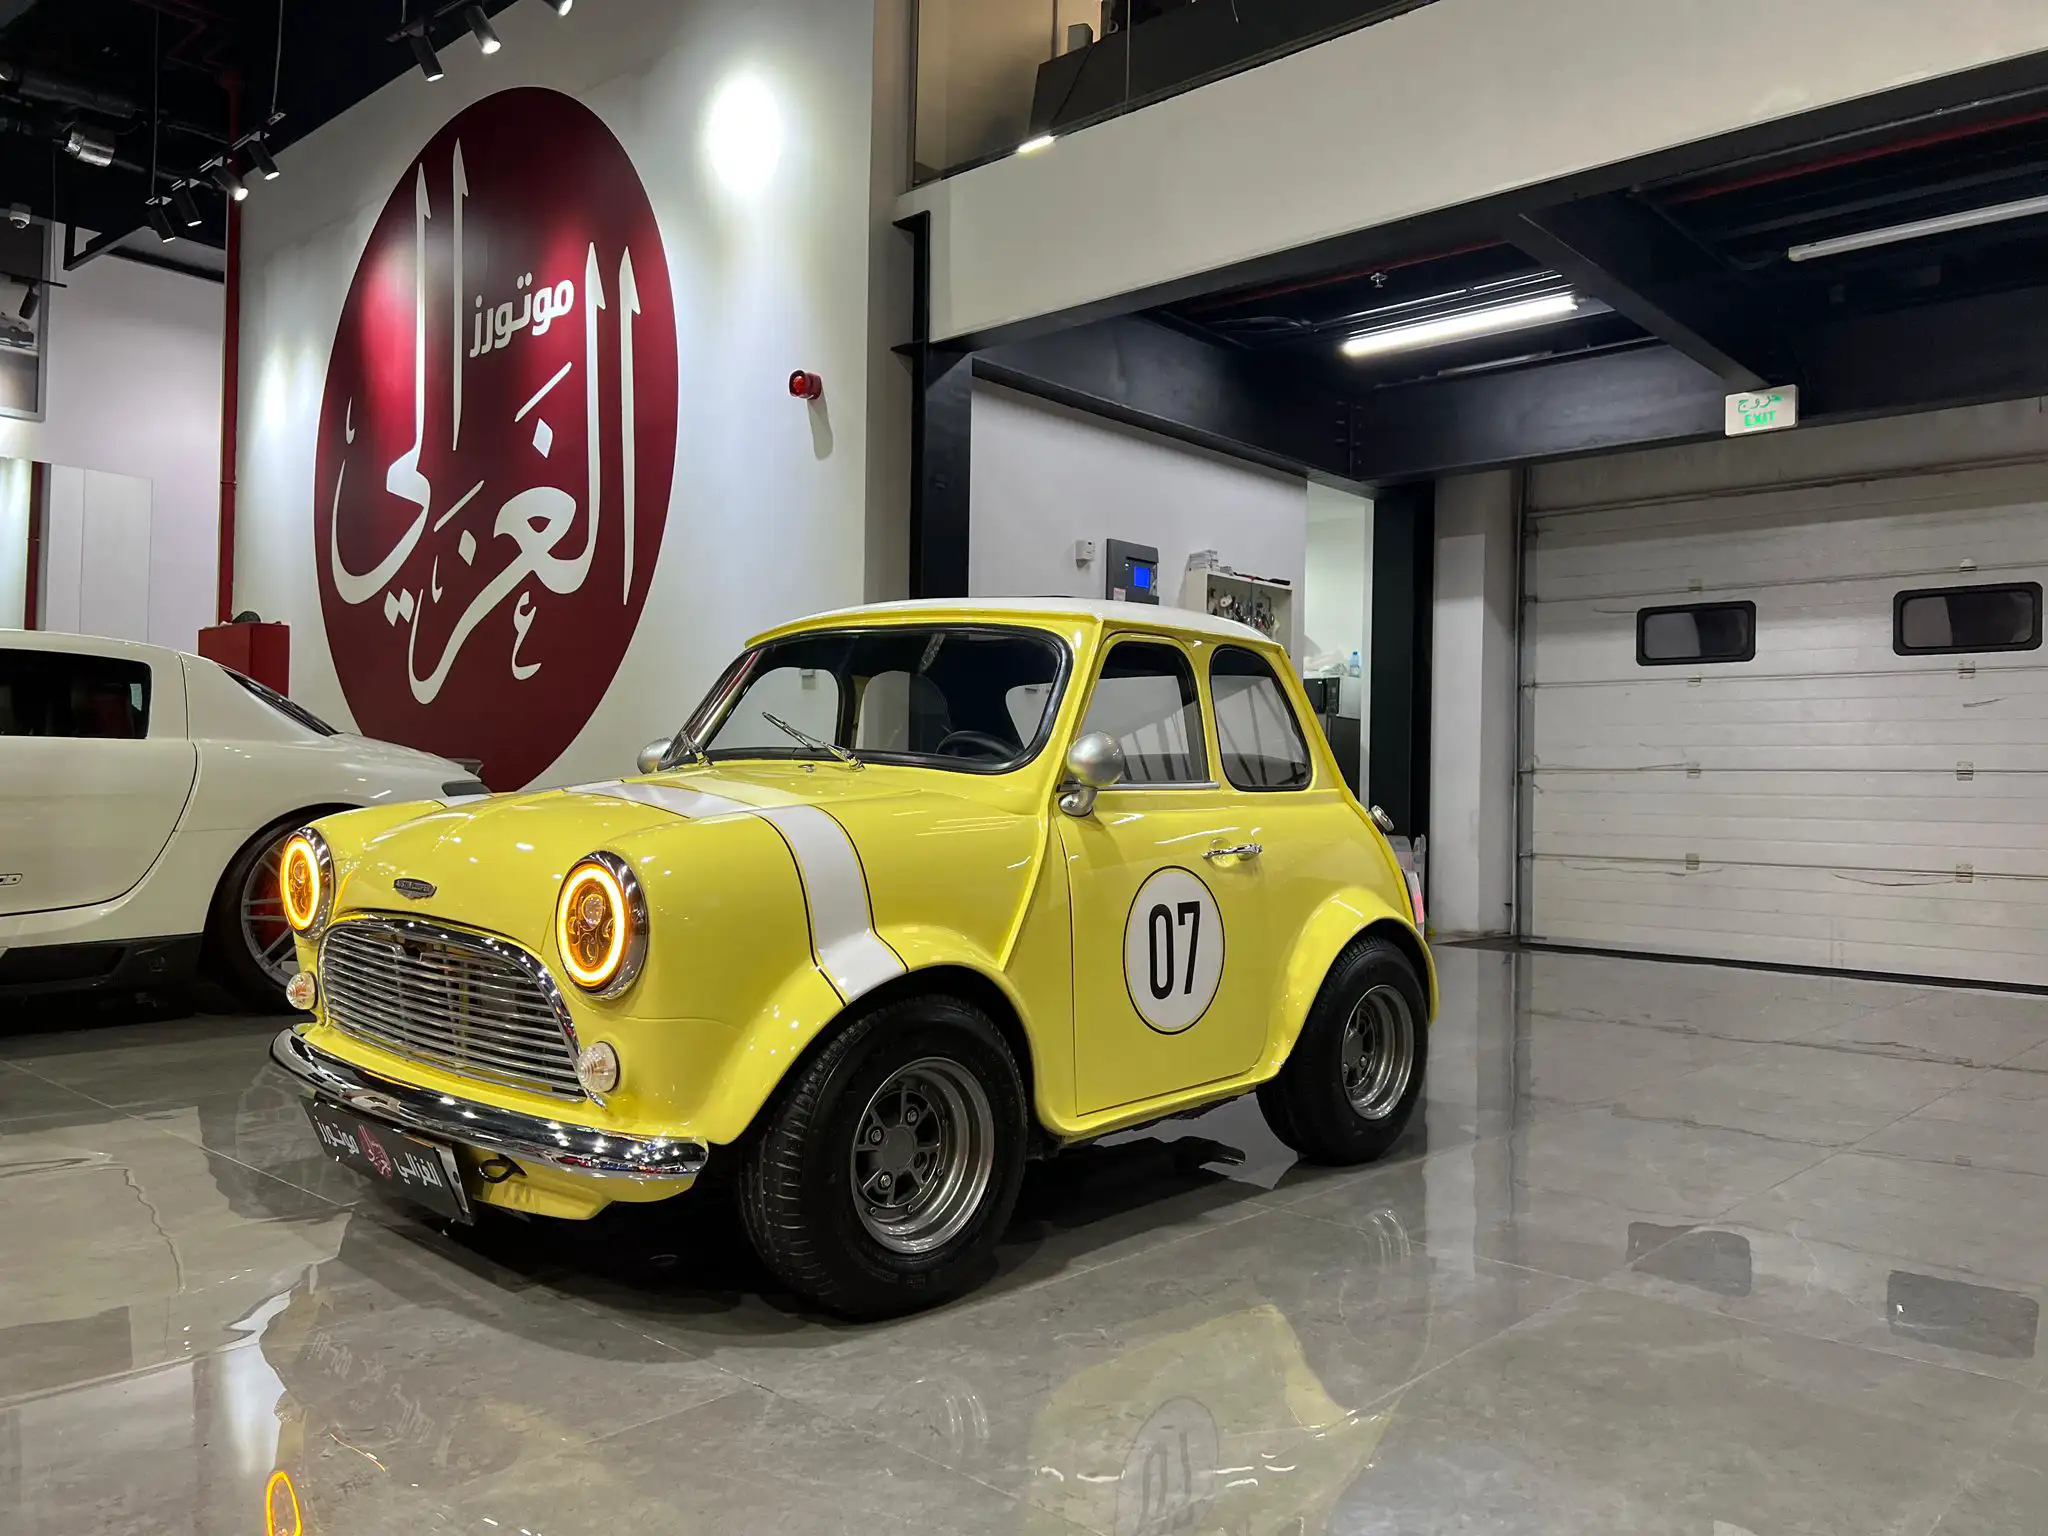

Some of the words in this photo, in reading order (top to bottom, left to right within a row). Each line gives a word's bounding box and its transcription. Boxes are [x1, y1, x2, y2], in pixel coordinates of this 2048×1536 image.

[469, 272, 575, 358] موتورز
[1745, 410, 1776, 427] EXIT
[1148, 900, 1201, 1000] 07
[314, 1115, 361, 1155] موتورز
[393, 1152, 443, 1188] الغزالي
